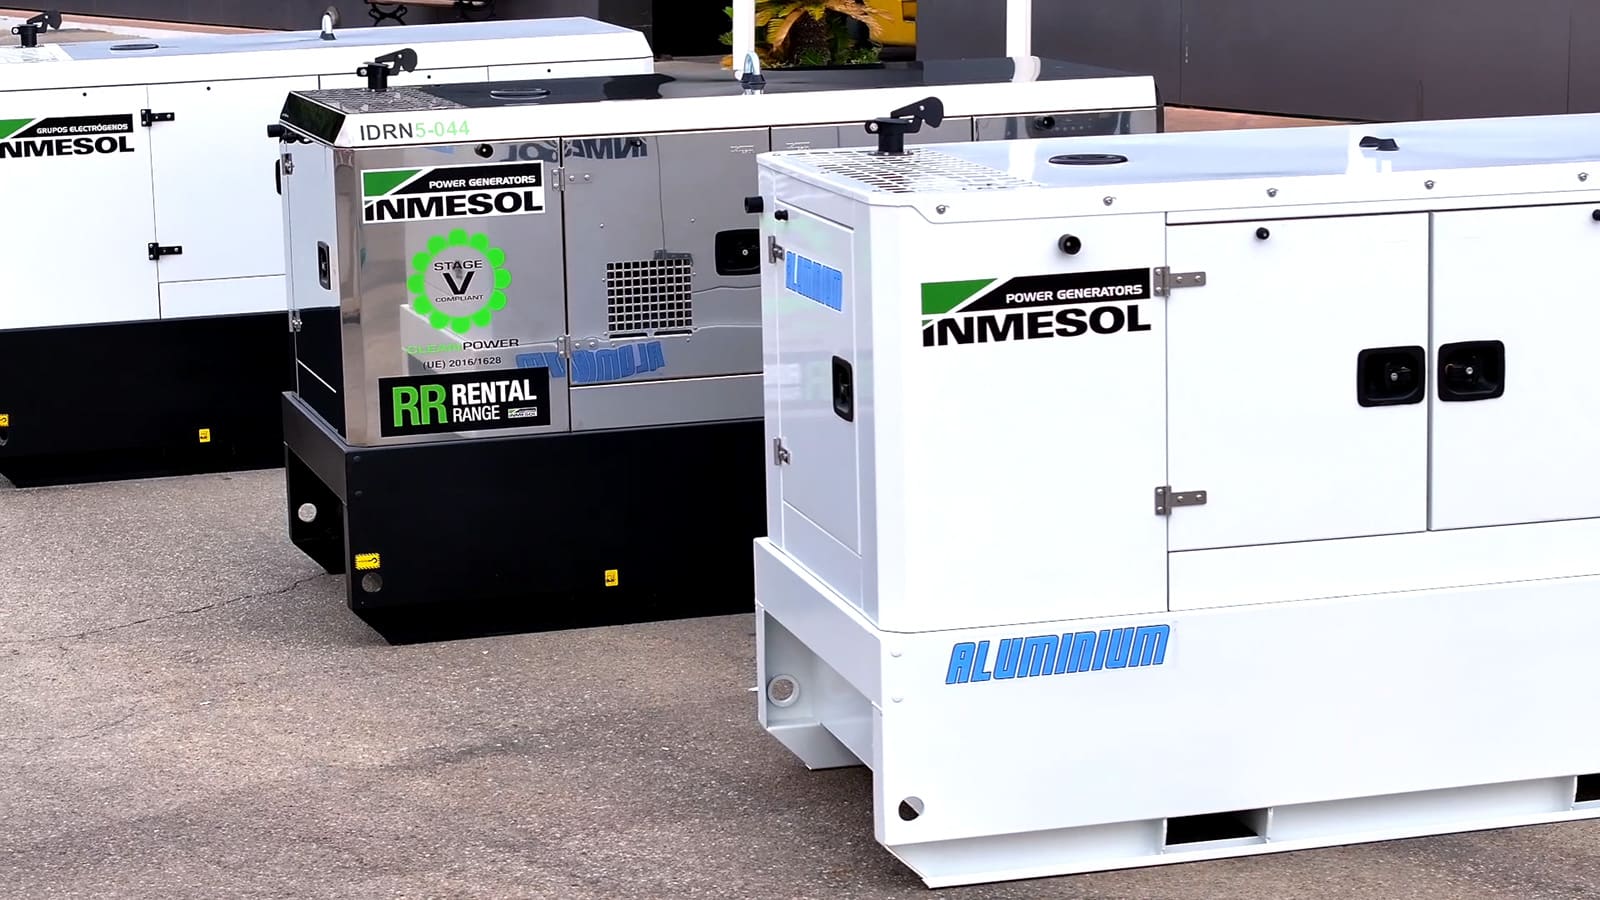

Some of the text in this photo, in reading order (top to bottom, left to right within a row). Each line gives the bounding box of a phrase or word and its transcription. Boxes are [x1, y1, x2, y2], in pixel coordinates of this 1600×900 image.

[36, 126, 68, 134] GRUPOS
[429, 175, 536, 189] POWER GENERATORS
[364, 191, 543, 222] INMESOL
[434, 260, 483, 271] STAGE
[442, 271, 475, 295] V
[435, 294, 484, 303] COMPLIANT
[1005, 284, 1143, 304] POWER GENERATORS
[922, 305, 1151, 347] INMESOL
[422, 356, 502, 370] (UE) 2016/1628
[392, 379, 537, 427] RR RENTAL
[453, 405, 500, 423] RANGE
[945, 624, 1170, 684] ALUMINIUM
